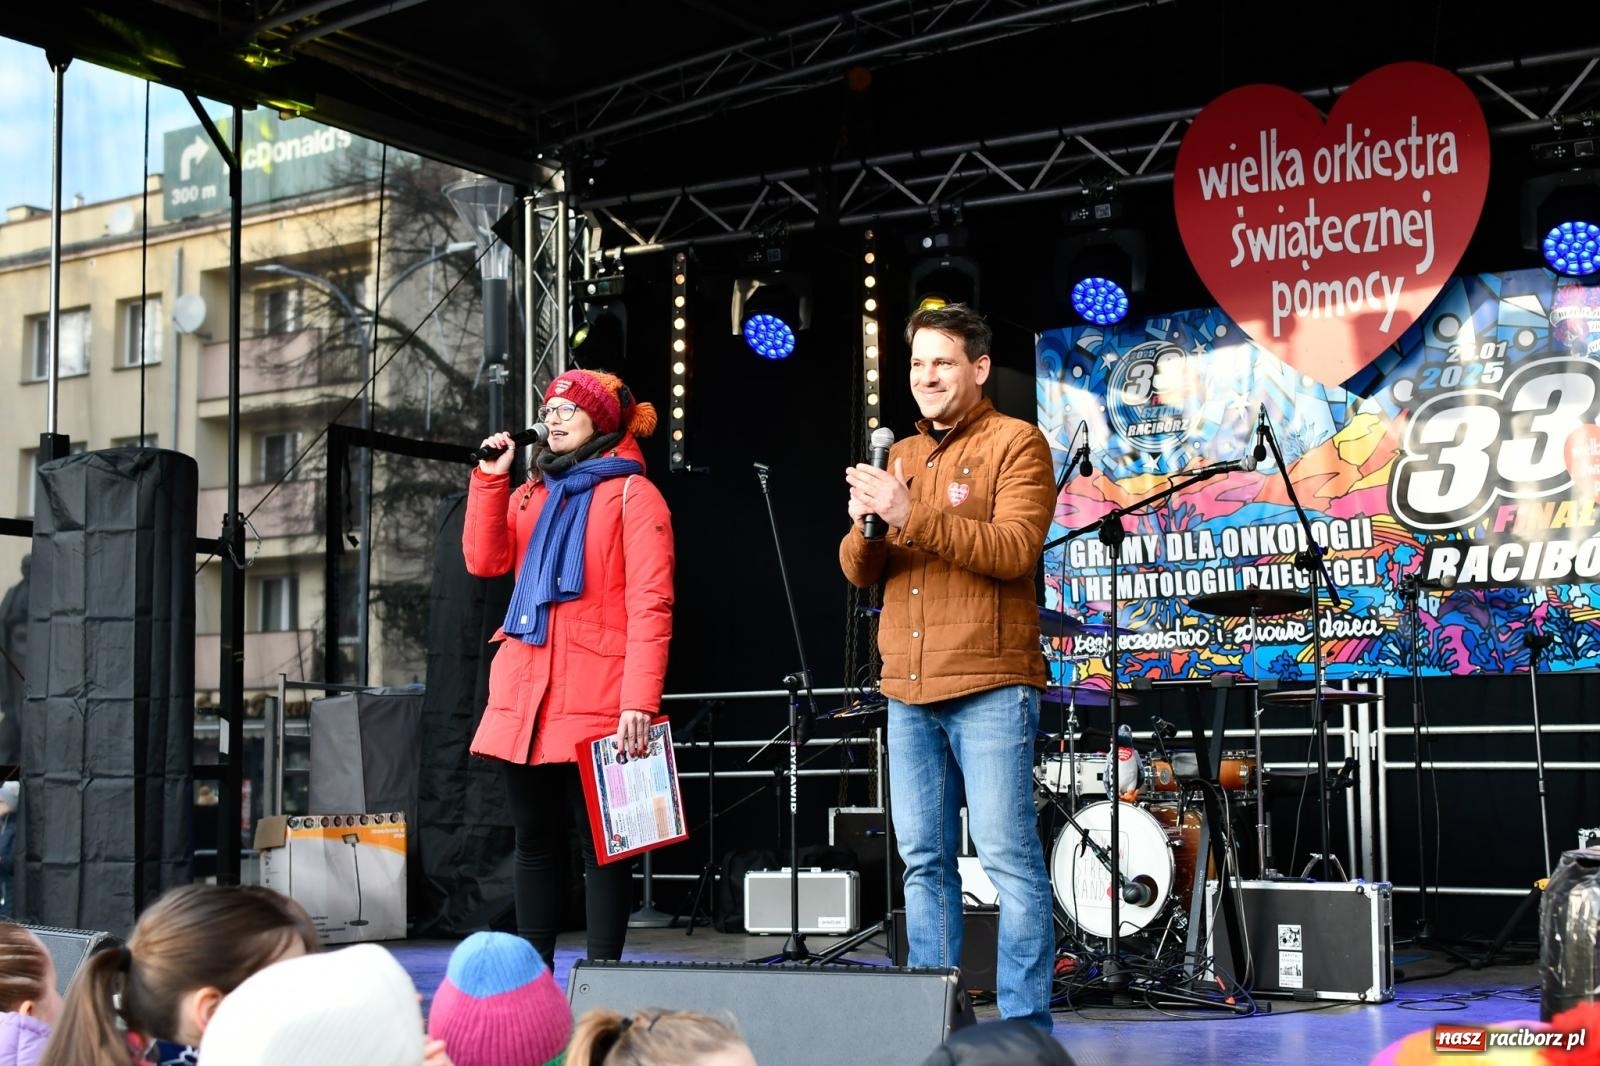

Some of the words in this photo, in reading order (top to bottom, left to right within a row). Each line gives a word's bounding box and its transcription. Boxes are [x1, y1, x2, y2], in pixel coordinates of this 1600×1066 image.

[1198, 128, 1305, 201] wielka
[1313, 116, 1458, 184] orkiestra
[171, 186, 199, 206] 300
[202, 184, 216, 199] m
[1230, 190, 1435, 275] świątecznej
[1272, 270, 1405, 337] pomocy
[1446, 342, 1508, 363] 2.01
[1419, 362, 1504, 390] 2025
[1402, 368, 1598, 518] 33
[1166, 529, 1216, 562] DLA
[1071, 577, 1079, 602] I
[1085, 568, 1236, 601] HEMATOLOGII
[1216, 621, 1223, 643] i
[1319, 609, 1383, 639] dzieci
